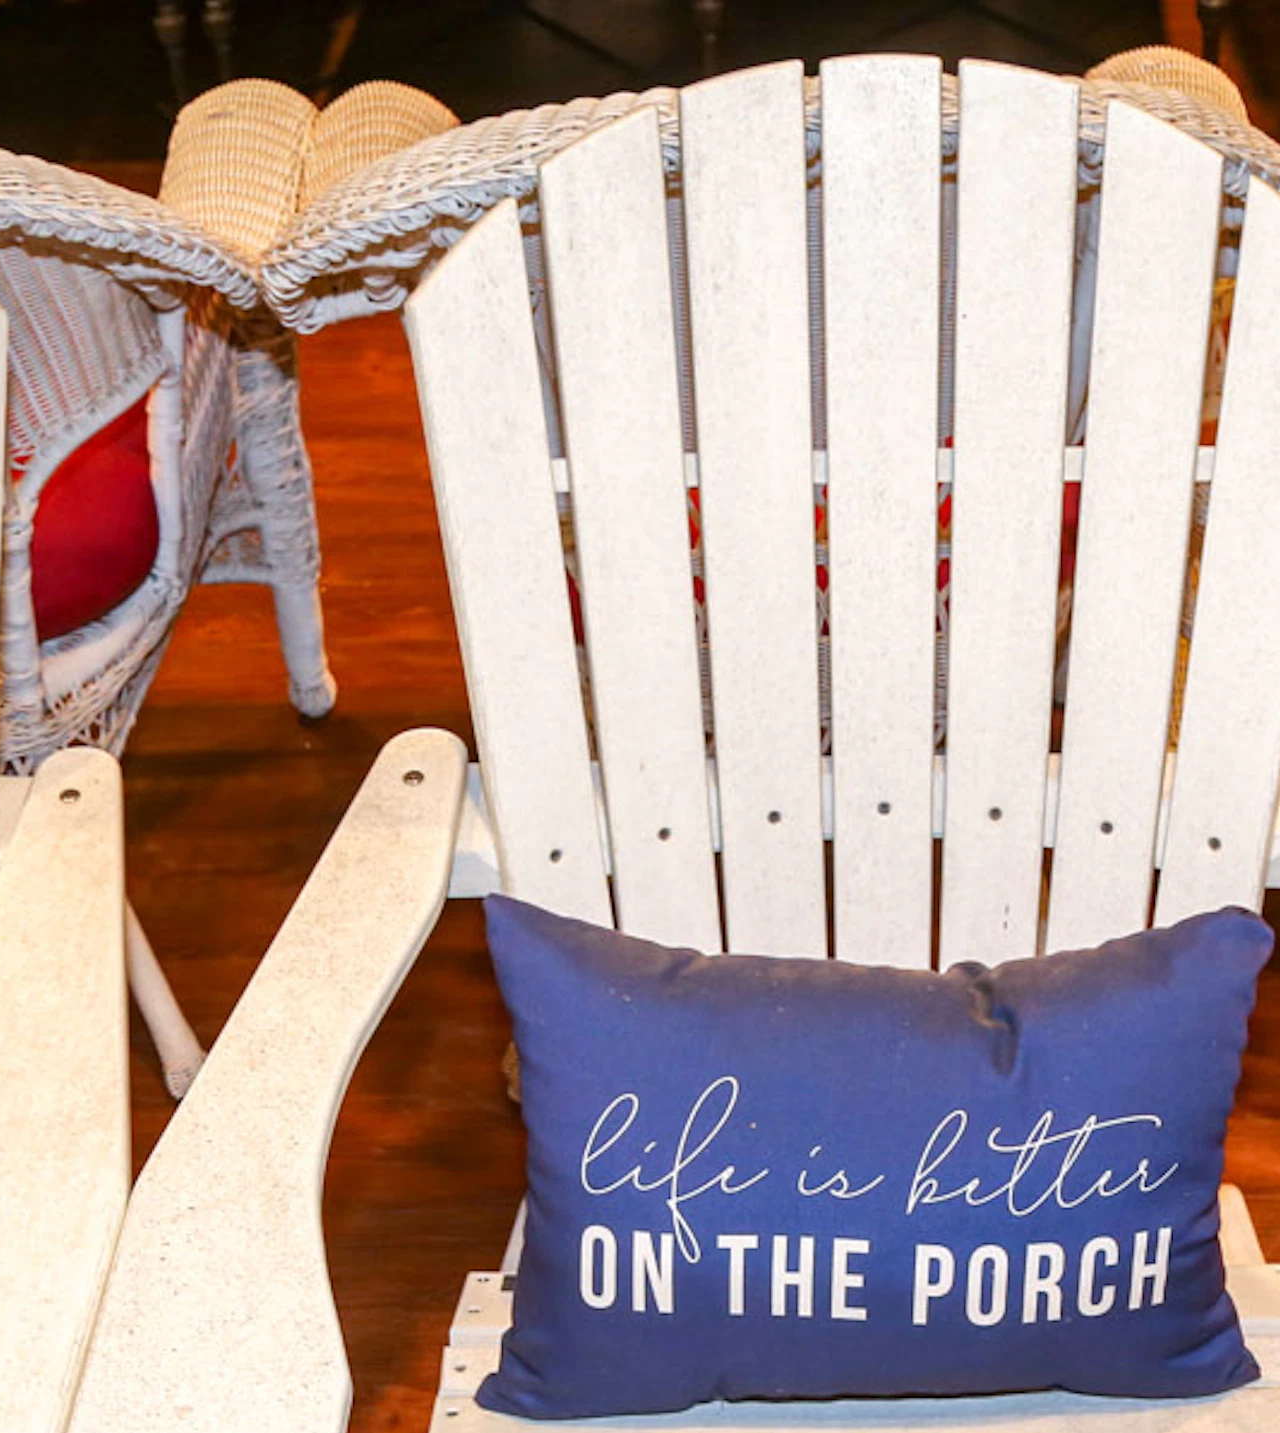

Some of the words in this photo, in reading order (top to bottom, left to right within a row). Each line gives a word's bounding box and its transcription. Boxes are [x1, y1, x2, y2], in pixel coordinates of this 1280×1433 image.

[580, 1076, 770, 1264] life
[797, 1145, 885, 1200] is
[906, 1109, 1180, 1217] better
[579, 1224, 675, 1315] ON
[716, 1233, 871, 1322] THE
[911, 1225, 1174, 1327] PORCH
